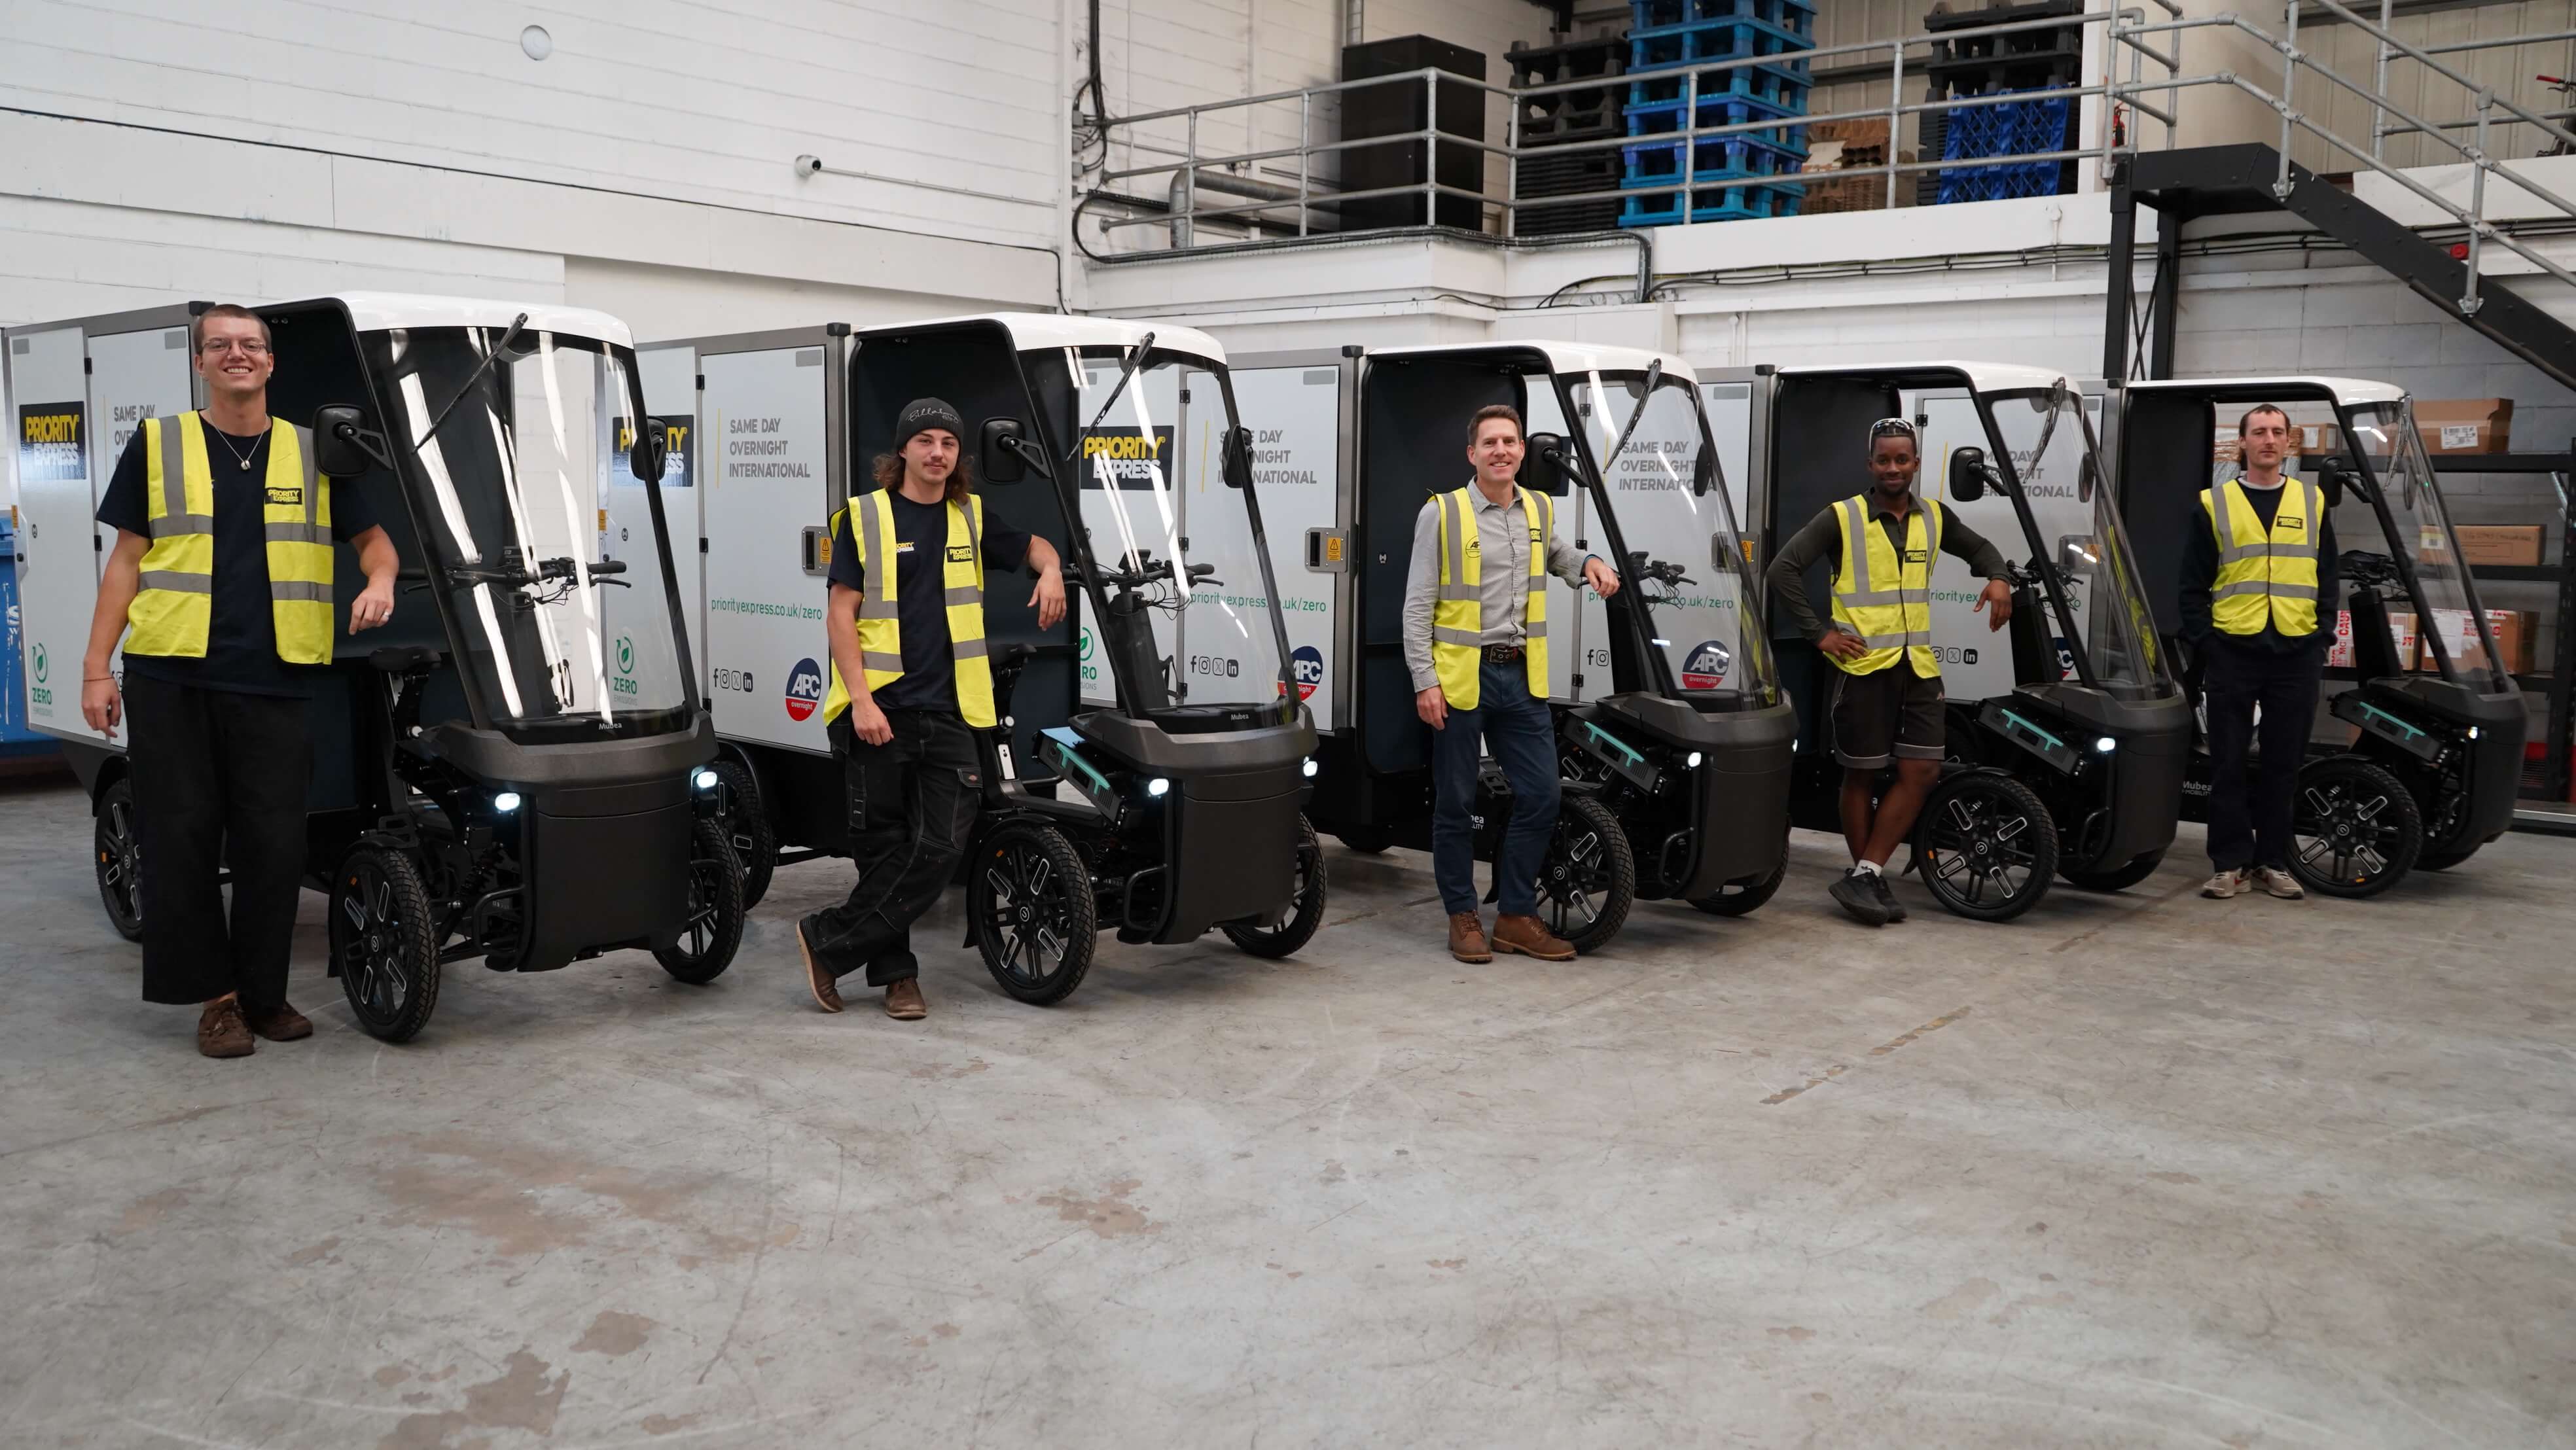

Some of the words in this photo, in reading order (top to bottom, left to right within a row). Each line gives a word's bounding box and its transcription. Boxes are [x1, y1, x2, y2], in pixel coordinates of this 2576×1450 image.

[114, 406, 137, 422] SAME
[139, 404, 156, 419] DAY
[26, 414, 78, 442] PRIORITY
[730, 419, 758, 433] SAME
[761, 418, 781, 433] DAY
[1259, 430, 1283, 443] DAY
[34, 442, 79, 466] EXPRESS
[730, 440, 788, 455] OVERNIGHT
[1083, 436, 1163, 459] PRIORITY
[1622, 442, 1658, 453] SAME
[1664, 441, 1689, 453] DAY
[729, 463, 811, 478] INTERNATIONAL
[711, 596, 823, 620] priorityexpress.co.uk/zero
[1690, 653, 1728, 674] APC
[1082, 665, 1097, 680] RO
[613, 677, 637, 694] ZERO
[791, 673, 820, 698] APC
[32, 687, 52, 705] ZERO
[791, 701, 813, 711] overnight
